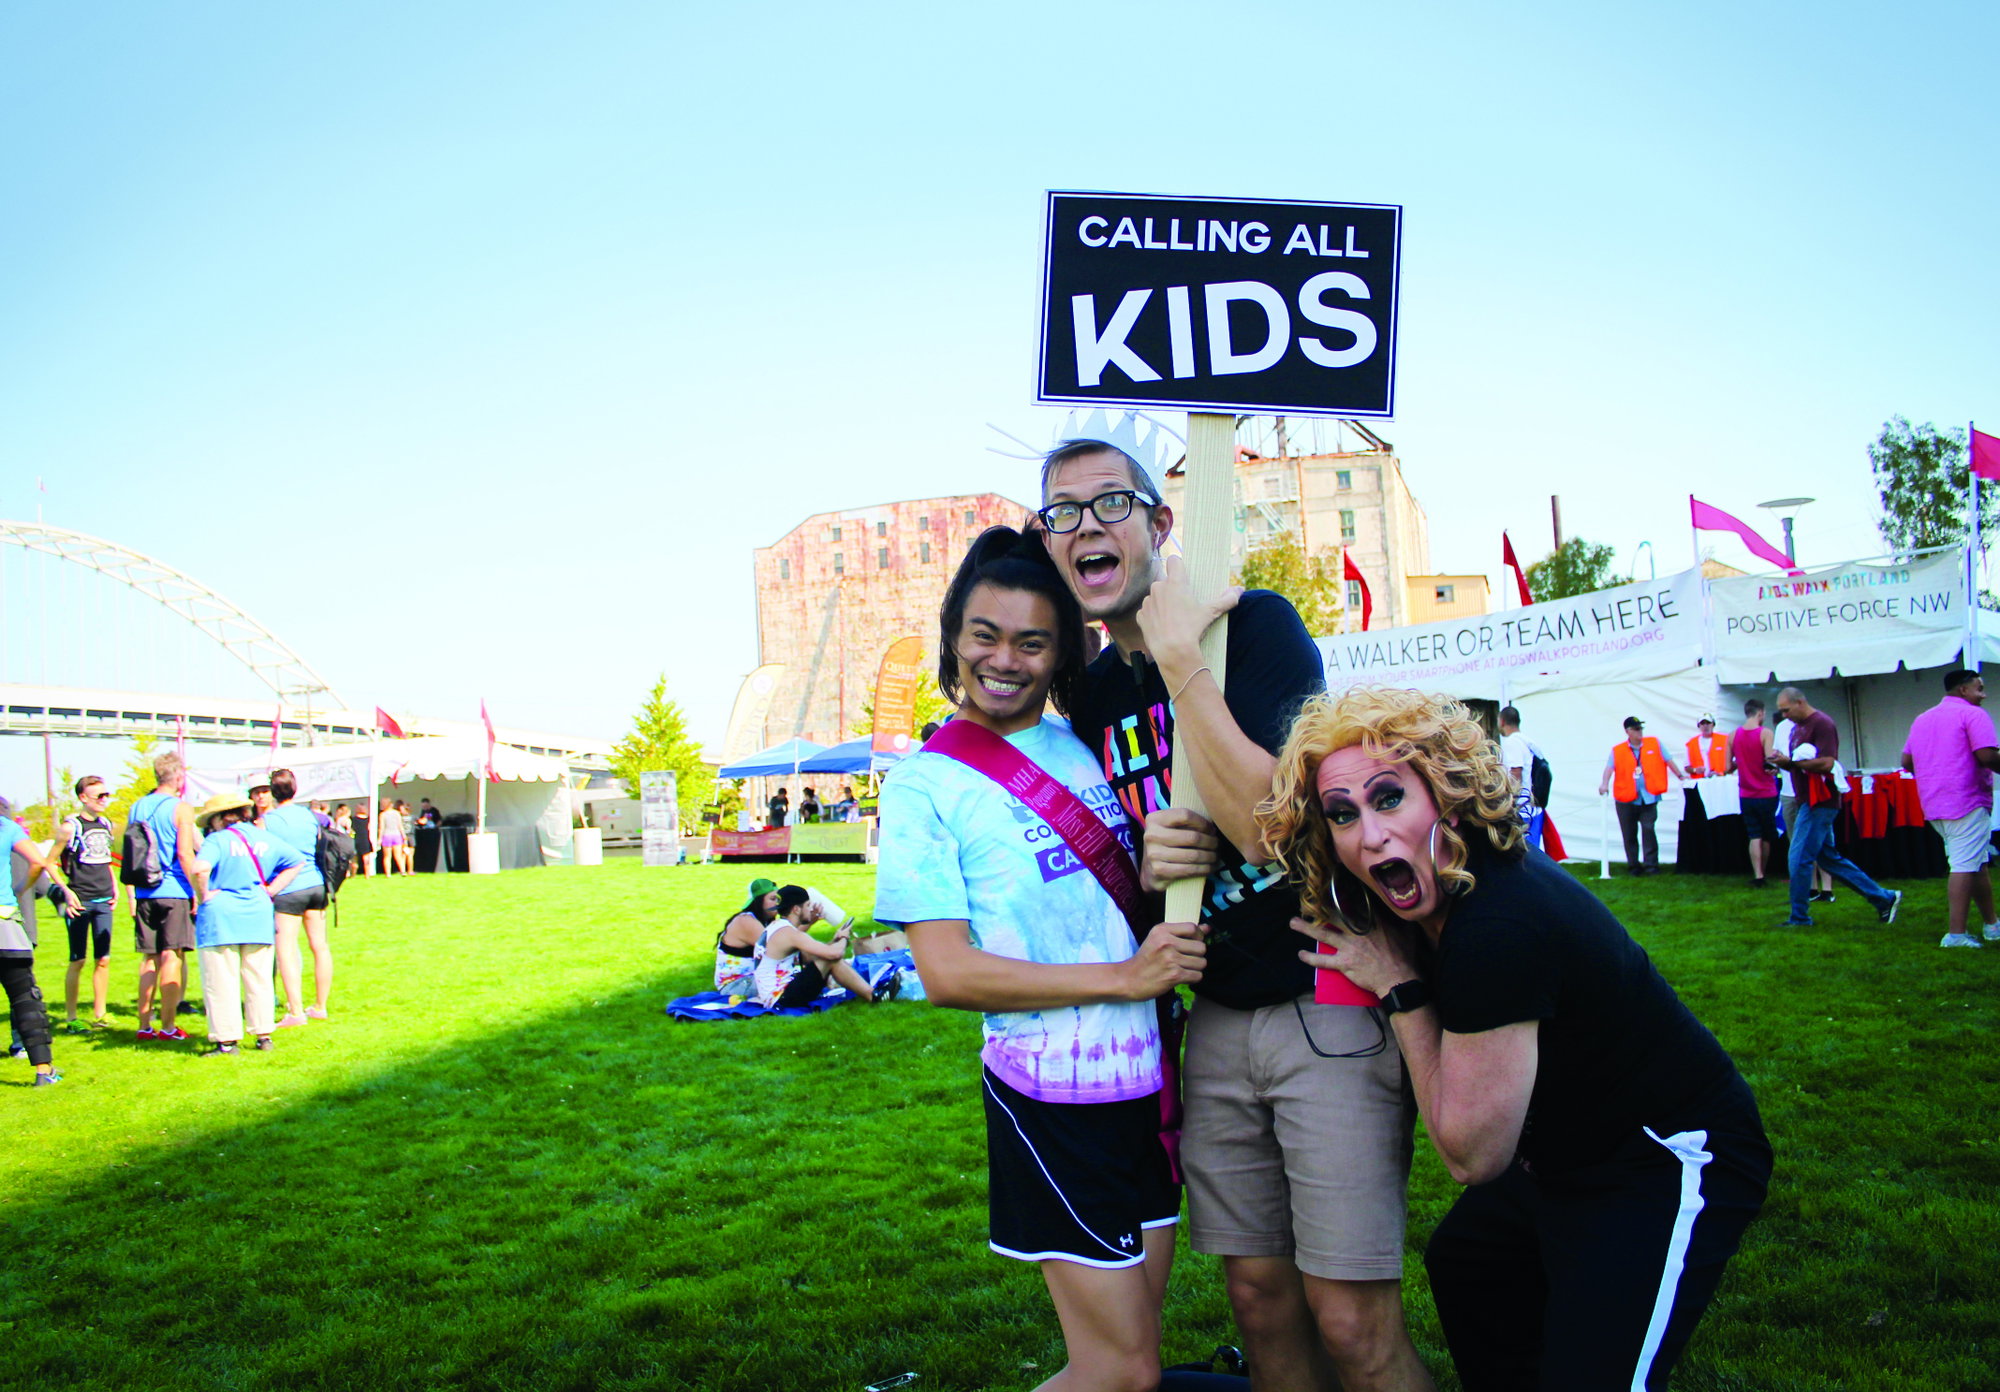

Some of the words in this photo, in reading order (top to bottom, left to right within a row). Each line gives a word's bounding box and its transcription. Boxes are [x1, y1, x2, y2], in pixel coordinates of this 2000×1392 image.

[1078, 215, 1272, 254] CALLING
[1283, 223, 1370, 259] ALL
[1071, 271, 1378, 388] KIDS
[1758, 583, 1789, 600] AIDS
[1792, 580, 1831, 597] WALK
[1834, 569, 1911, 590] PORTLAND
[1327, 649, 1341, 673] A
[1347, 633, 1448, 670] WALKER
[1456, 626, 1493, 656] OR
[1501, 610, 1585, 648] TEAM
[1591, 589, 1680, 635] HERE
[1727, 608, 1820, 635] POSITIVE
[1827, 598, 1900, 624] FORCE
[1910, 591, 1951, 615] NW
[1379, 670, 1407, 682] YOUR
[1409, 659, 1480, 681] SMARTPHONE
[1484, 659, 1495, 670] AT
[1497, 627, 1666, 668] AIDSWALKPORTLAND.ORG
[1104, 699, 1175, 782] AID
[308, 765, 355, 782] PRIZES
[1008, 762, 1041, 797] MHA
[1074, 784, 1114, 805] KID
[1118, 768, 1172, 830] WA
[1024, 825, 1057, 843] CO
[1092, 802, 1125, 820] TIO
[1052, 801, 1086, 839] Miss
[1074, 822, 1114, 857] HIV
[1047, 848, 1081, 871] CA
